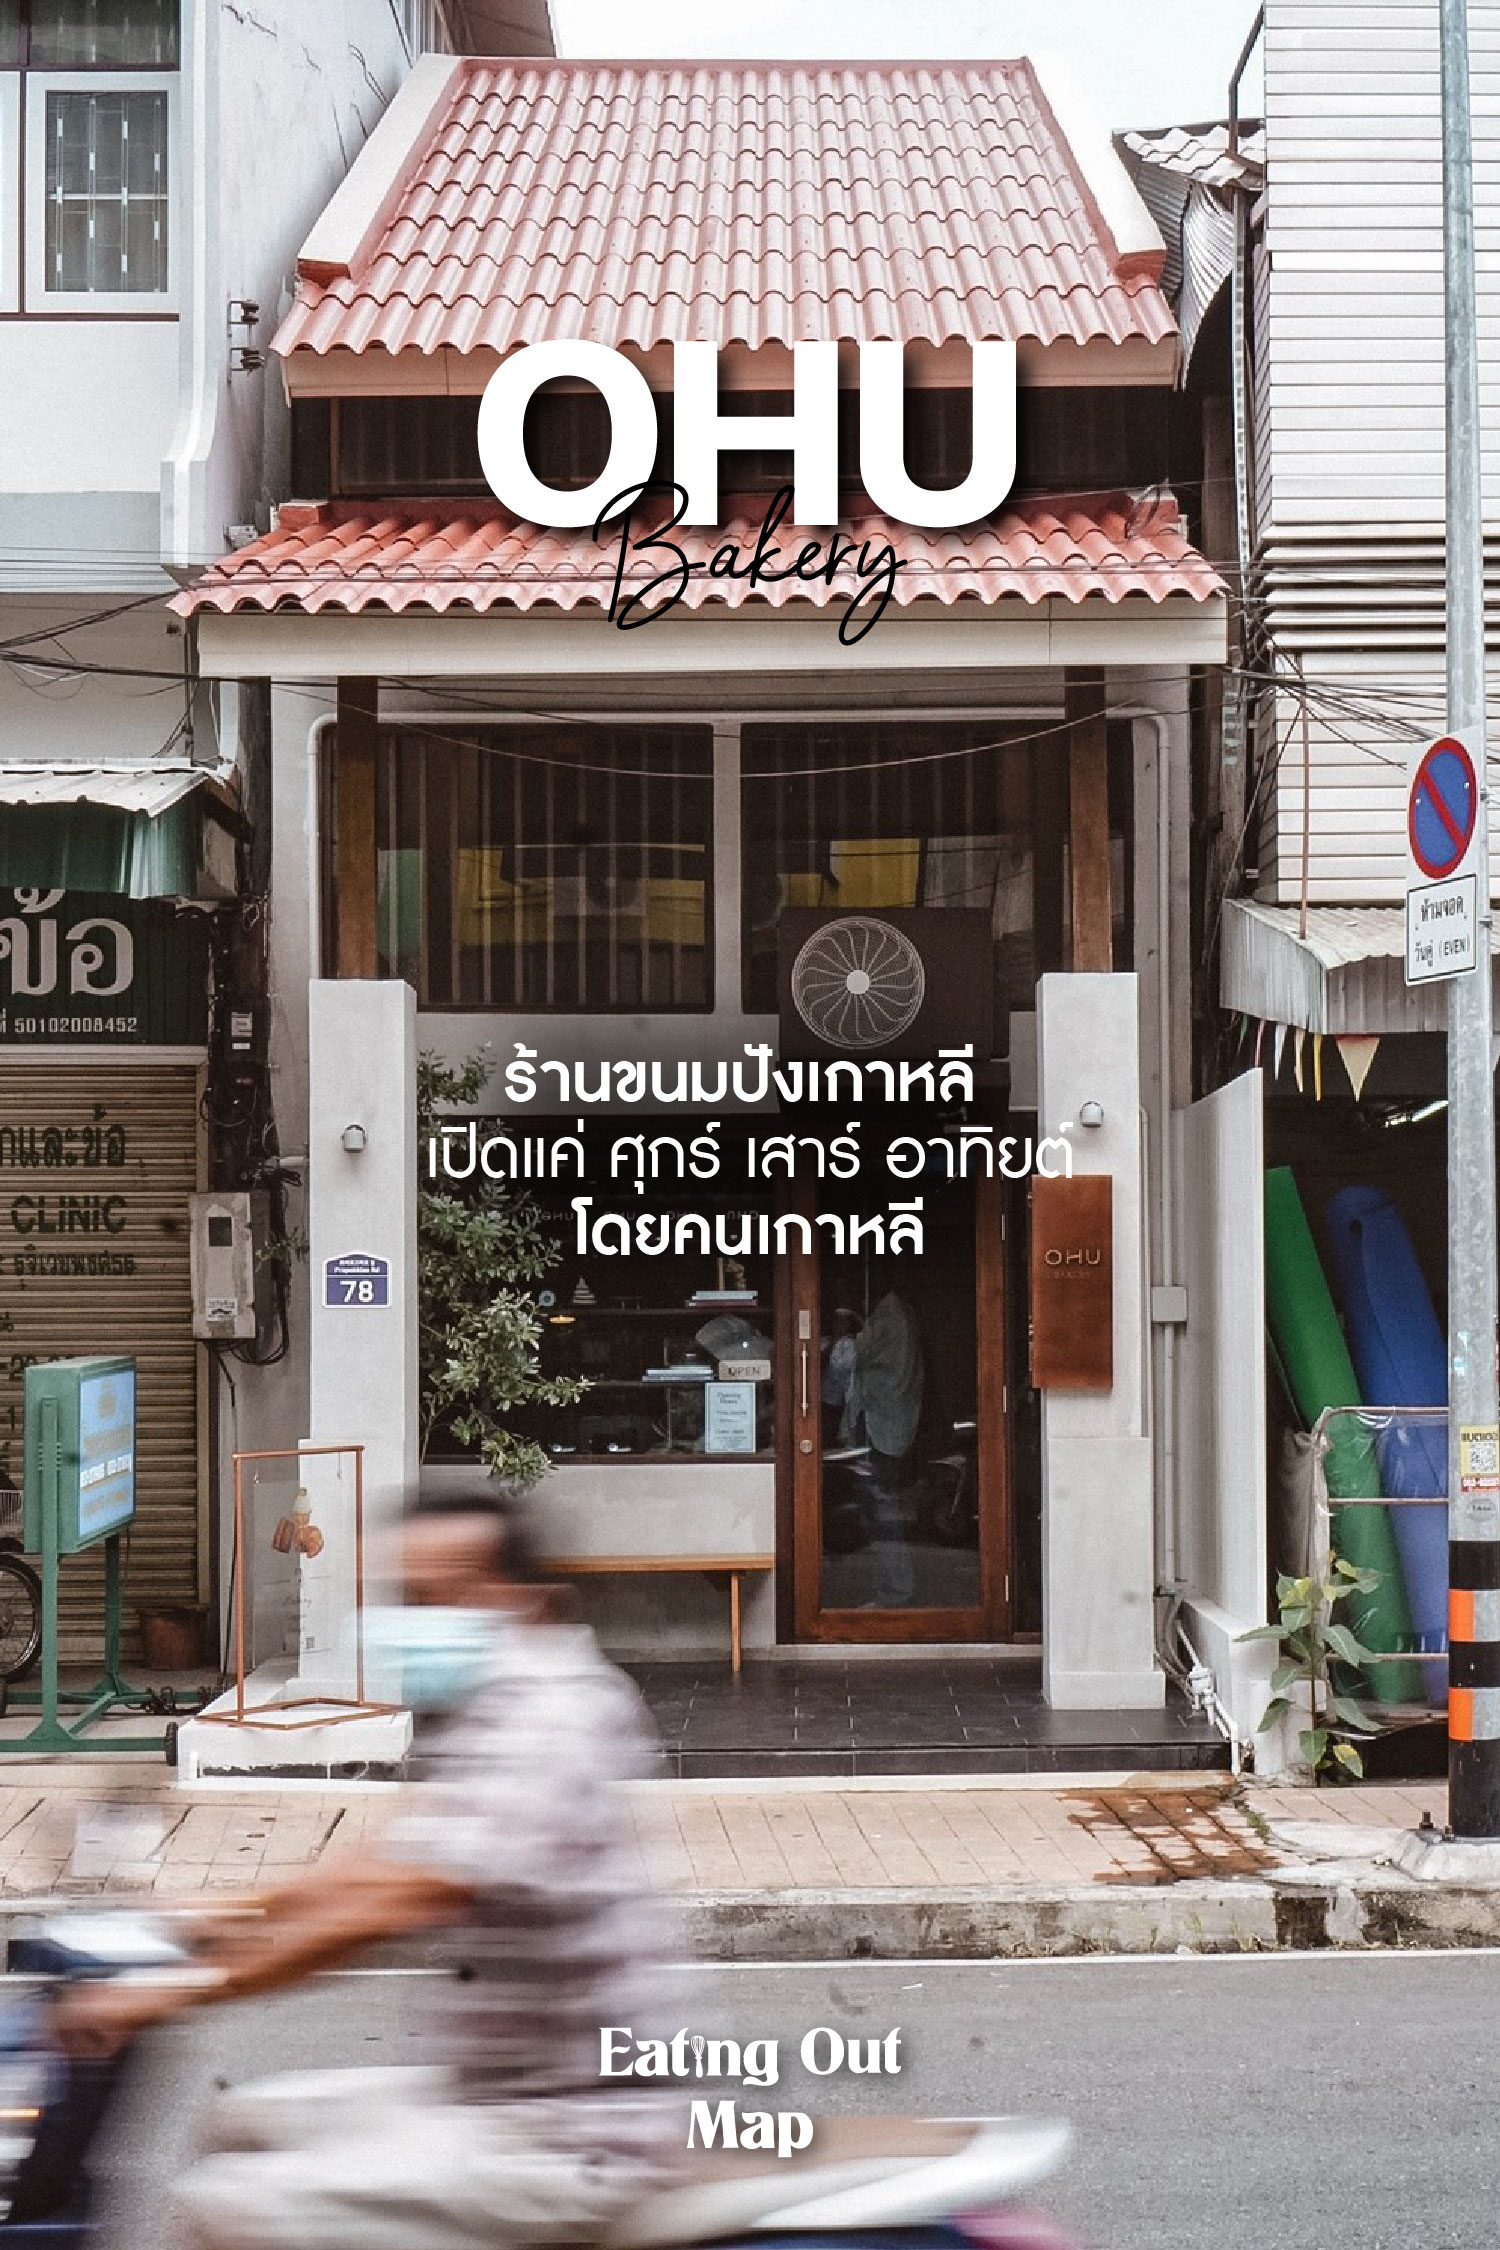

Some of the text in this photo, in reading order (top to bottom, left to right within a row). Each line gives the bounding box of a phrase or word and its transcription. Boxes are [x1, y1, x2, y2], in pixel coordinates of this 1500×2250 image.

[14, 1017, 138, 1033] 50102008452
[11, 1195, 128, 1234] CLINIC
[1045, 1249, 1101, 1265] OHU
[340, 1280, 374, 1303] 78
[728, 1366, 761, 1377] OPEN
